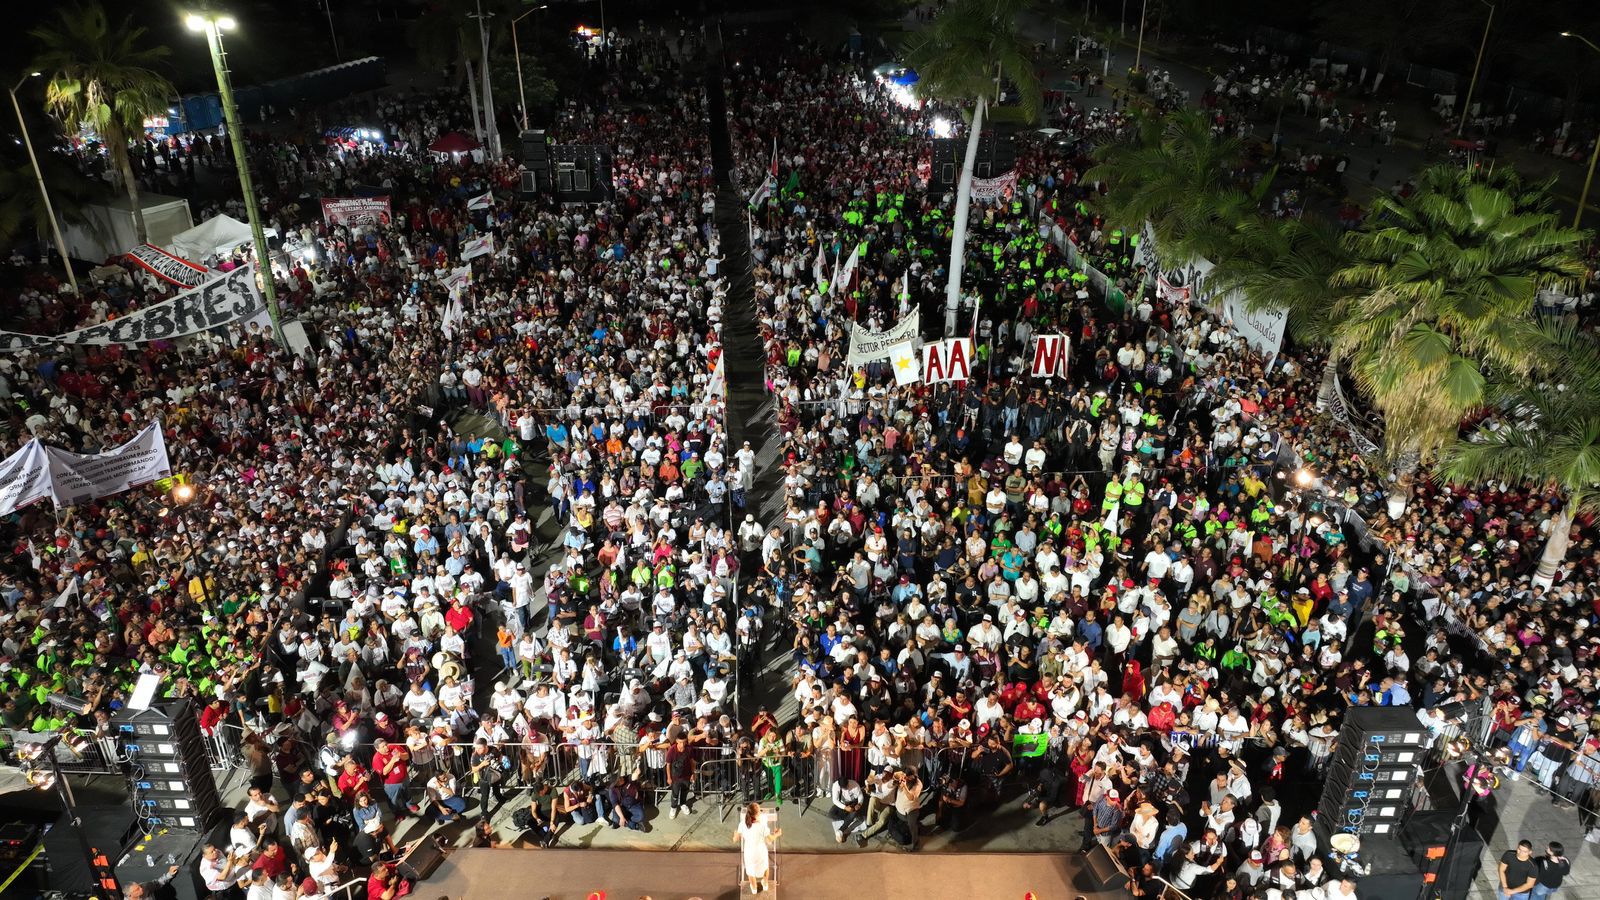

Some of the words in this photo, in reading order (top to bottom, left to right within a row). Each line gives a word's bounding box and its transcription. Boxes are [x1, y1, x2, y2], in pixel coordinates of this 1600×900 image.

[74, 267, 256, 343] POBRES
[857, 341, 880, 354] SECTOR
[926, 346, 944, 383] A
[948, 341, 969, 378] A
[1033, 338, 1058, 374] N
[137, 448, 158, 458] PARDO
